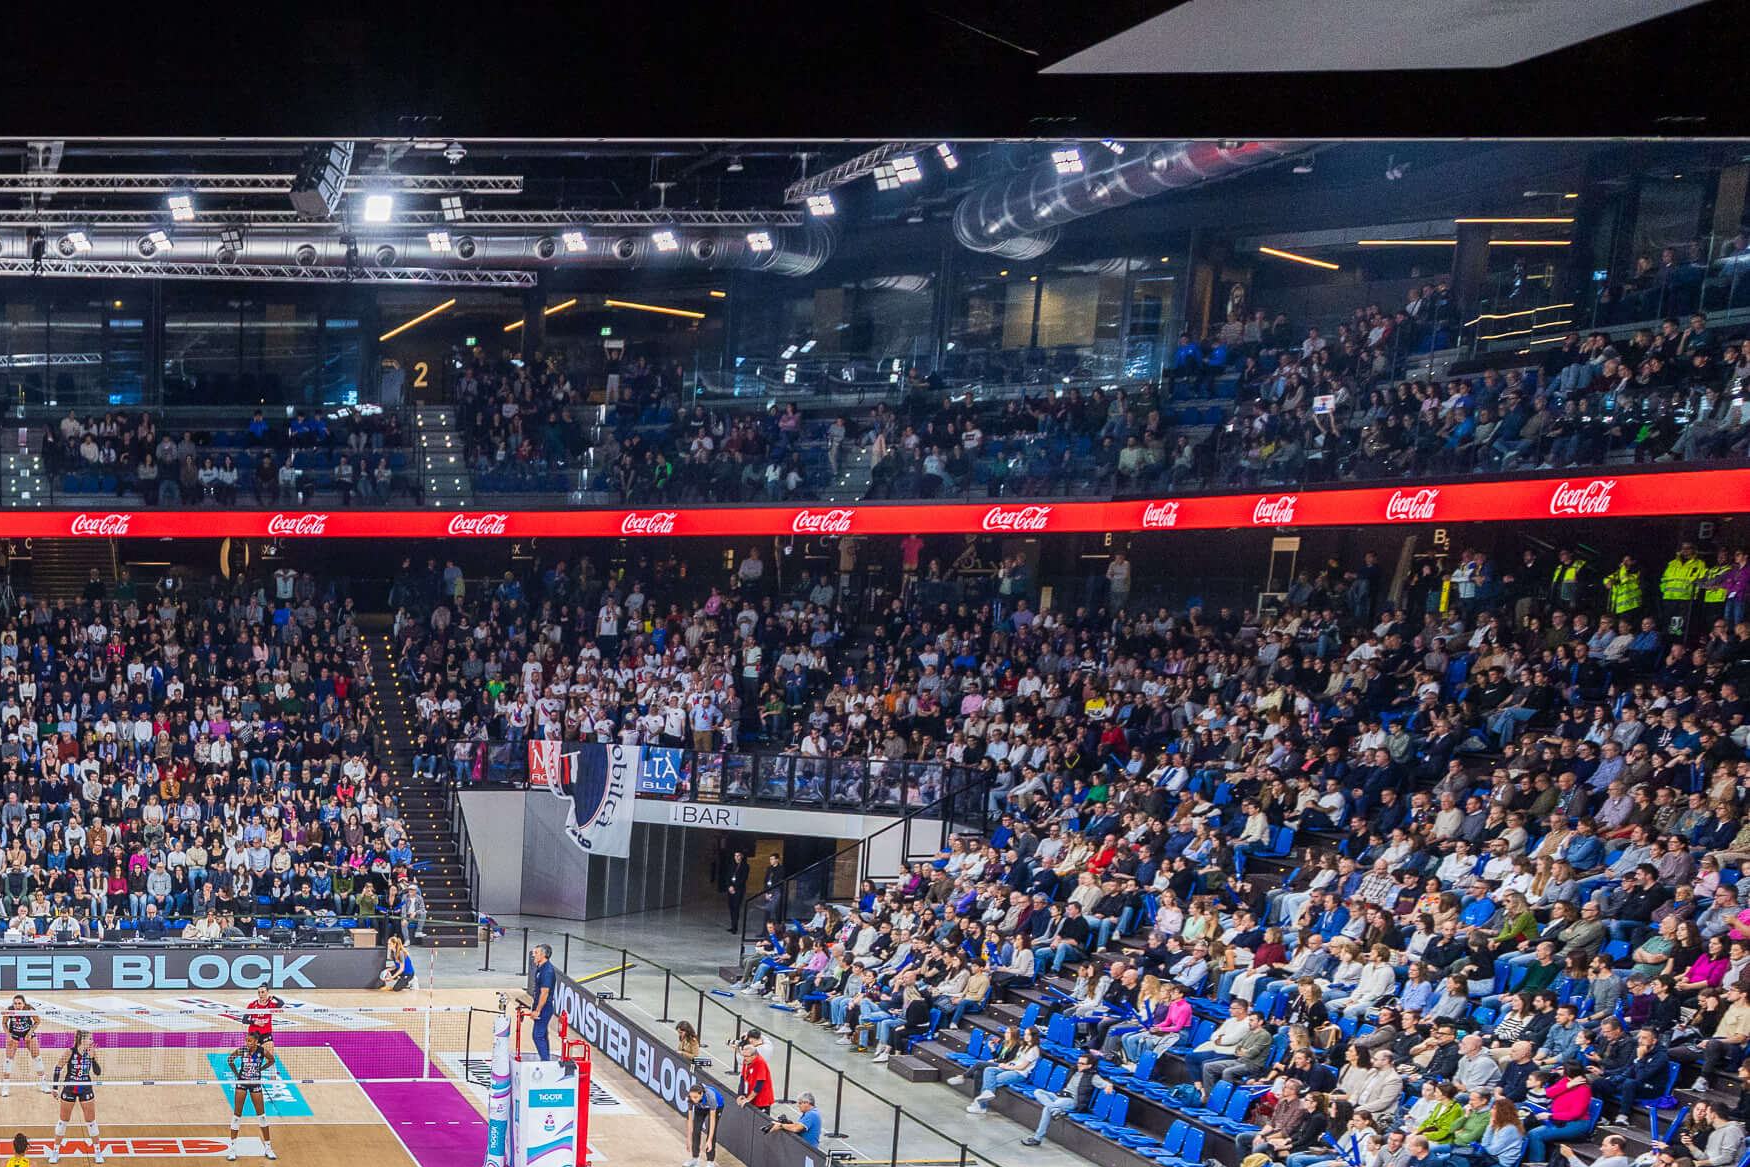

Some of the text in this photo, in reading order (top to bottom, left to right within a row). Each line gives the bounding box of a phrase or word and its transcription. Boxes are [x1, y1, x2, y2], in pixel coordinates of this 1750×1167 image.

[413, 361, 429, 388] 2
[682, 806, 731, 826] BAR
[130, 955, 316, 989] BLOCK
[553, 981, 697, 1114] MONSTER BLOC
